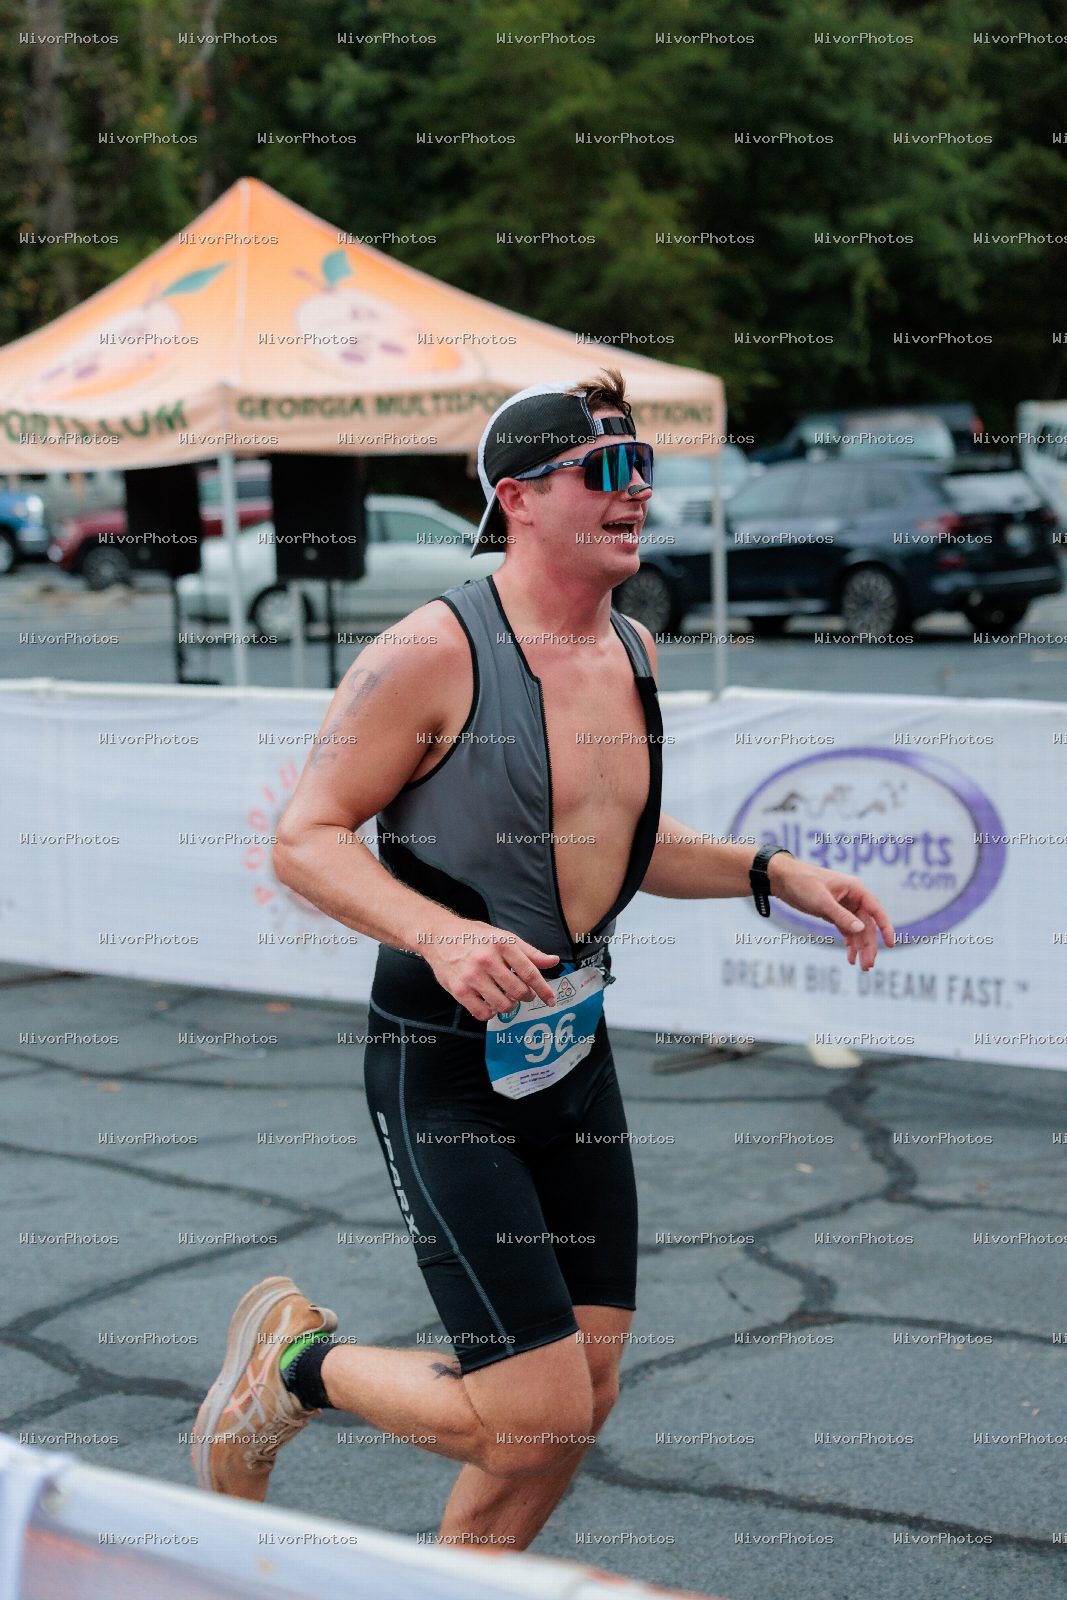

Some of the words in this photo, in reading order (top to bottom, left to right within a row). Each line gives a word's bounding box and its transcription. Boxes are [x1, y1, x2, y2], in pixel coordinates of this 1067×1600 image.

[237, 394, 365, 420] GEORGIA
[903, 868, 957, 890] .com
[721, 958, 796, 989] DREAM
[804, 964, 850, 997] BIG.
[856, 968, 938, 1001] DREAM
[524, 1012, 577, 1063] 96
